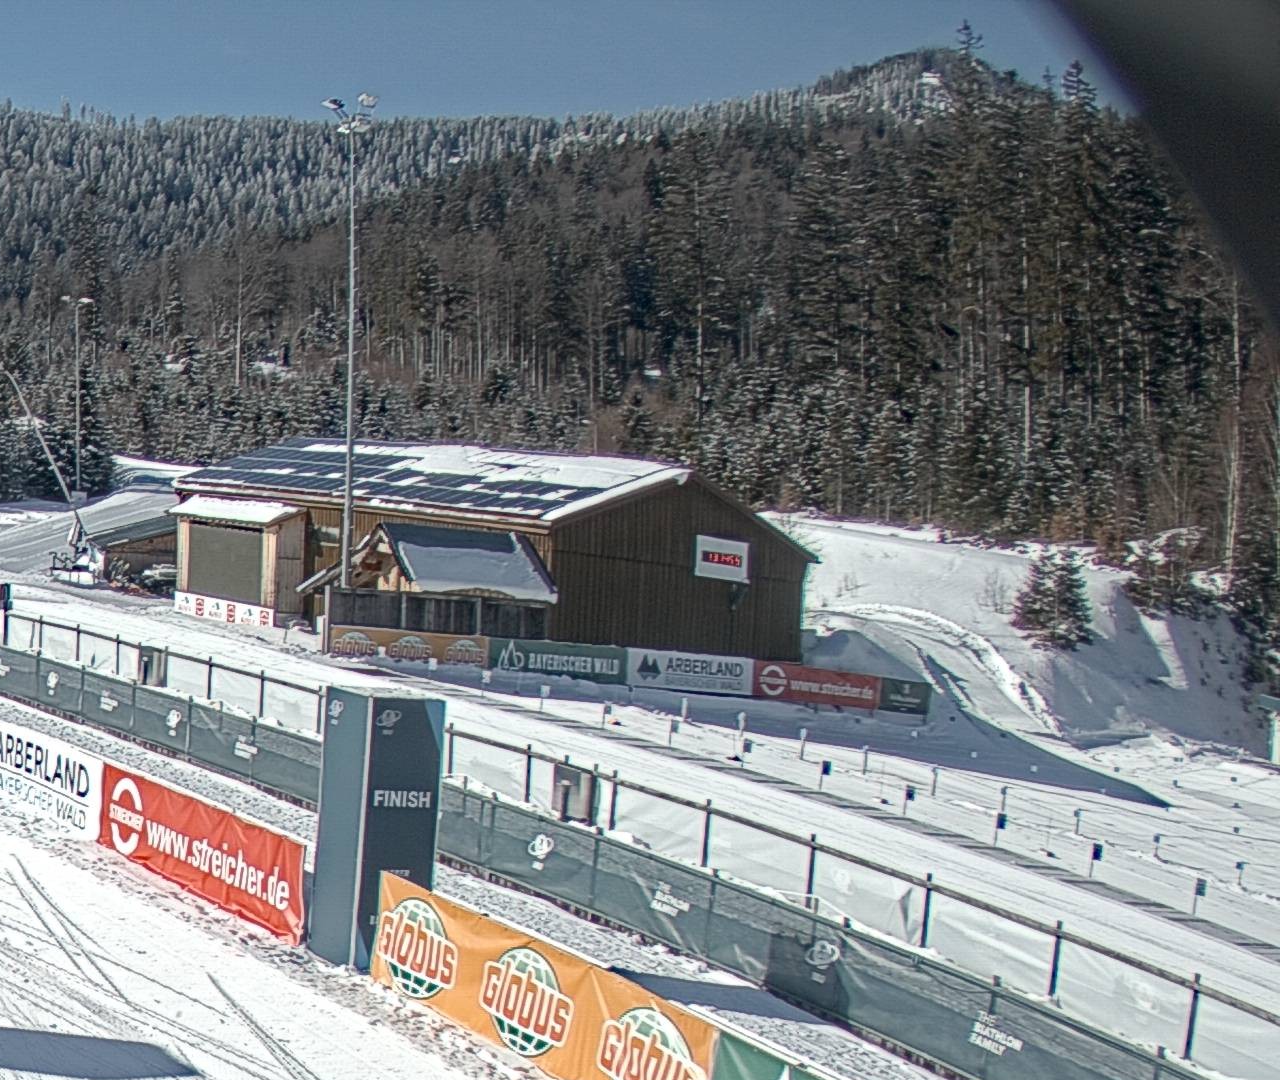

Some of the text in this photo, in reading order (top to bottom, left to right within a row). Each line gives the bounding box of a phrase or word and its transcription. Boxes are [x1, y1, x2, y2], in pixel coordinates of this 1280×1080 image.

[528, 652, 621, 675] BAYERISCHER WALD
[665, 656, 744, 677] ARBERLAND
[373, 789, 432, 809] FINISH
[56, 797, 87, 830] WALD
[146, 819, 290, 911] www.streicher.de
